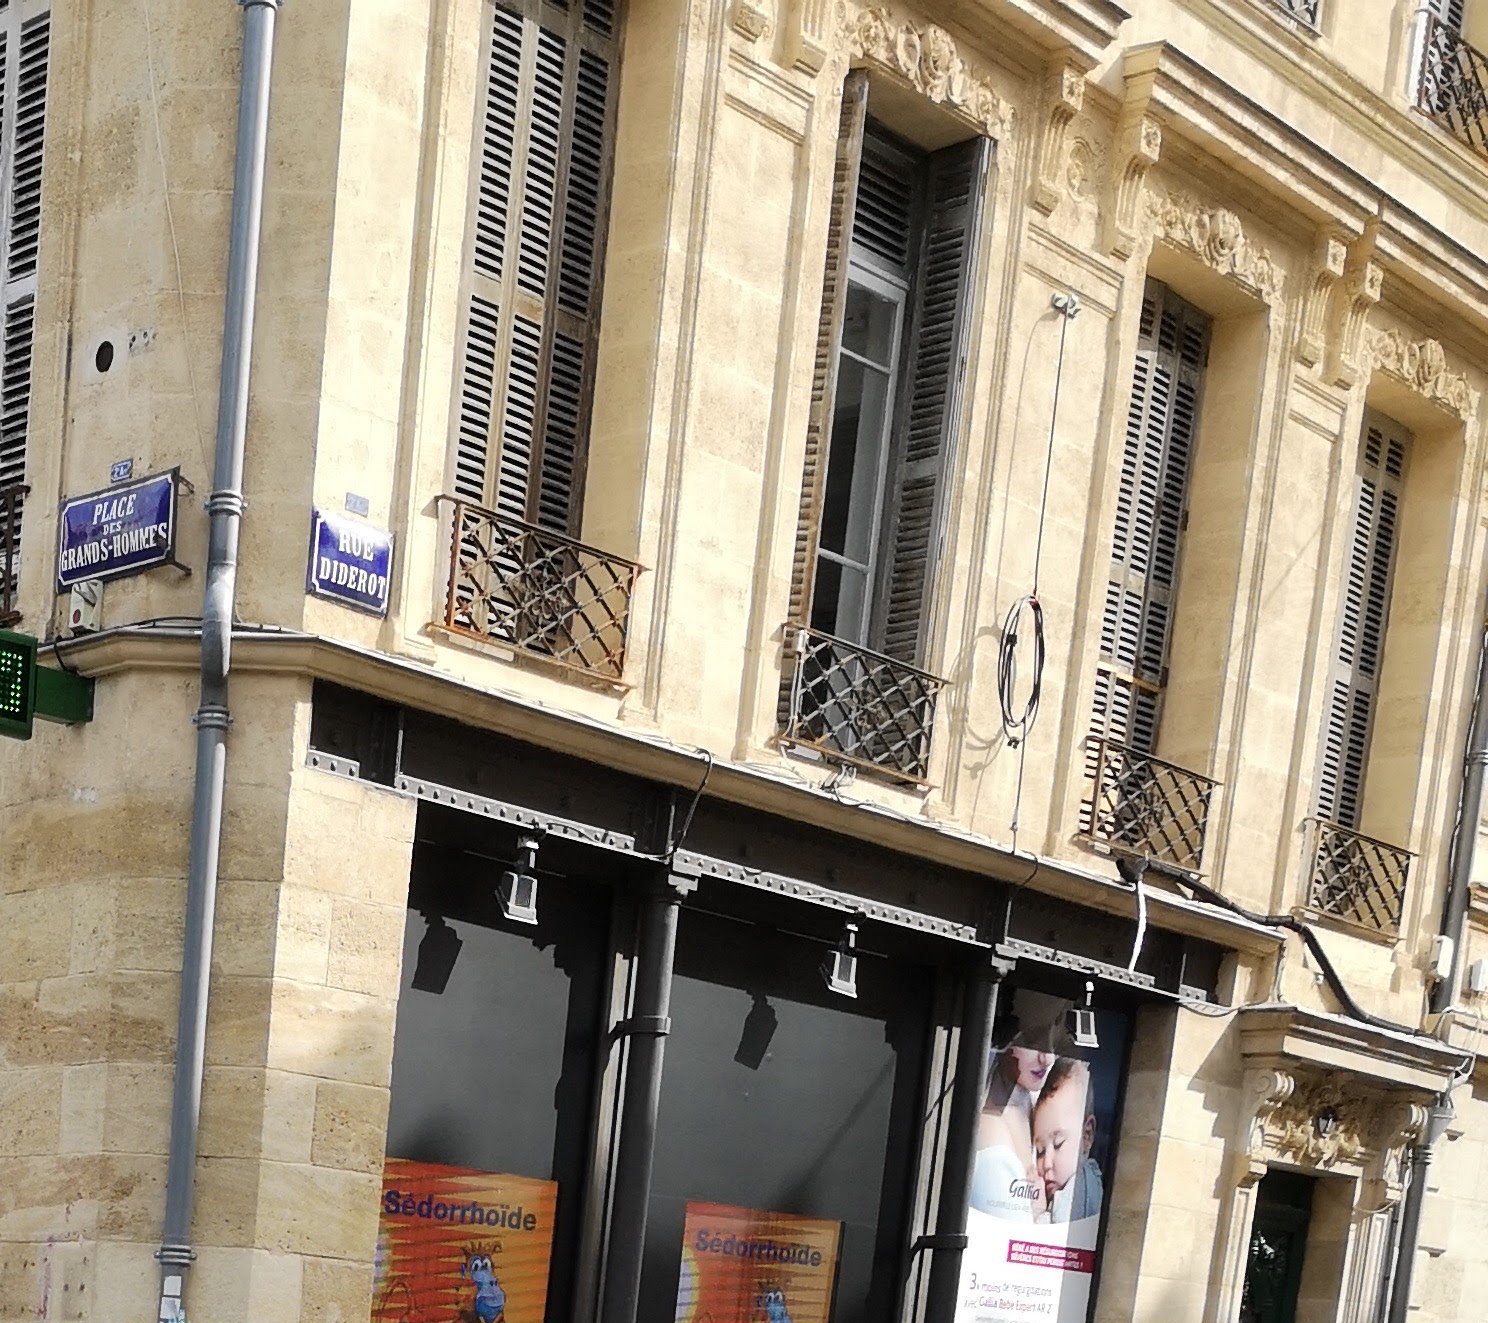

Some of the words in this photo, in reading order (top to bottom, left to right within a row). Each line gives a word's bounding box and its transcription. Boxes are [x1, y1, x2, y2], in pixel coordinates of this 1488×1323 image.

[92, 493, 137, 526] PLACE
[102, 520, 123, 536] DES
[61, 522, 168, 572] GRANDS-HOMMES
[338, 530, 375, 562] RUE
[318, 556, 387, 600] DIDEROT
[1009, 1178, 1041, 1201] Gallia
[384, 1189, 538, 1232] Sédorrhoïde
[694, 1227, 823, 1268] Sédorrhoïde
